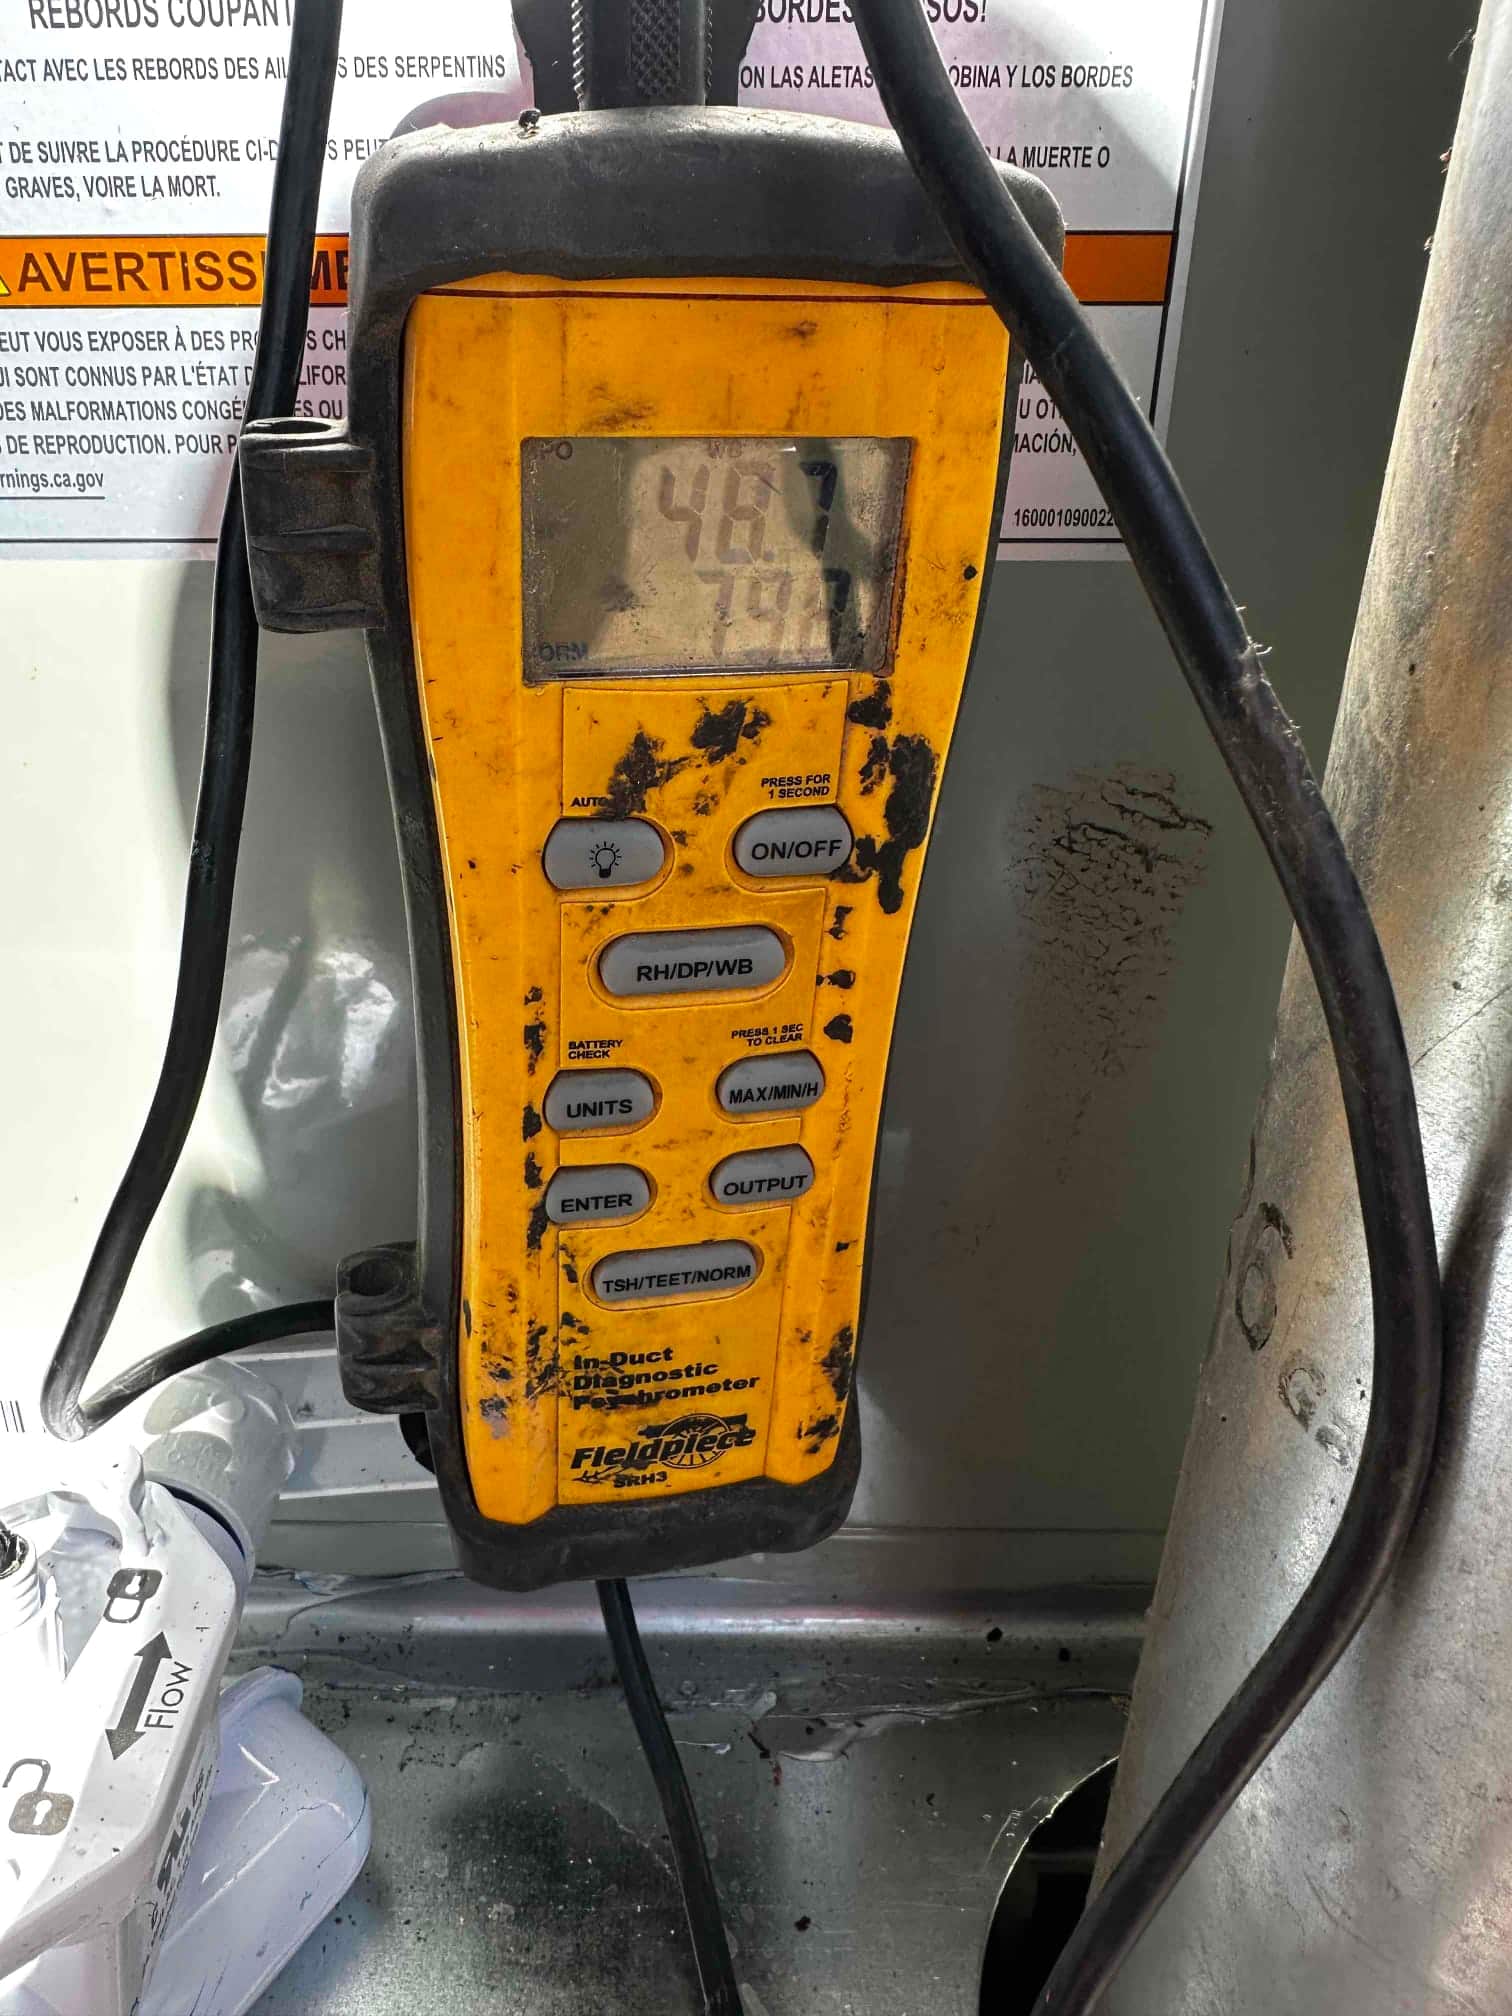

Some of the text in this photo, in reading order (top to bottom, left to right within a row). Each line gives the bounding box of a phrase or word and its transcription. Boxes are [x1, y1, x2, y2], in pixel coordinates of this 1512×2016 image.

[29, 0, 160, 29] REBORDS
[0, 58, 37, 82] ACT
[43, 58, 89, 82] AVEC
[94, 58, 128, 81] LES
[133, 57, 219, 81] REBORDS
[224, 57, 260, 80] DES
[354, 56, 389, 78] DES
[395, 55, 506, 78] SERPENTINS
[740, 65, 874, 89] ON LAS ALETAS
[1006, 65, 1018, 88] Y
[1021, 65, 1056, 88] LOS
[1061, 65, 1134, 88] BORDES
[9, 141, 33, 164] DE
[38, 140, 101, 163] SUIVRE
[104, 140, 129, 163] LA
[132, 135, 241, 163] PROCÉDURE
[1023, 146, 1093, 169] MUERTE
[1098, 146, 1110, 168] O
[5, 175, 221, 202] GRAVES, VOIRE LA MORT.
[34, 331, 84, 352] VOUS
[87, 330, 170, 351] EXPOSER
[174, 325, 187, 351] À
[191, 331, 225, 351] DES
[14, 366, 60, 387] SONT
[65, 366, 138, 387] CONNUS
[141, 366, 178, 387] PAR
[181, 361, 239, 386] L'ÉTAT
[30, 400, 178, 421] MALFORMATIONS
[319, 400, 343, 419] OU
[6, 435, 30, 454] DE
[33, 434, 171, 455] REPRODUCTION.
[175, 434, 222, 454] POUR
[761, 774, 830, 788] PRESS FOR
[778, 786, 829, 798] SECOND
[752, 839, 842, 860] ON/OFF
[636, 958, 753, 982] RH/DP/WB
[731, 1027, 769, 1039] PRESS
[782, 1023, 803, 1033] SEC
[746, 1033, 802, 1047] TO CLEAR
[568, 1039, 623, 1050] BATTERY
[568, 1049, 610, 1060] CHECK
[729, 1082, 819, 1104] MAX/MIN/H
[566, 1099, 633, 1118] UNITS
[723, 1175, 808, 1196] OUTPUT
[560, 1193, 633, 1213] ENTER
[602, 1265, 752, 1293] TSH/TEET/NORM
[574, 1348, 673, 1370] In-Duct
[574, 1363, 719, 1390] Diagnostic
[614, 1471, 668, 1488] SRH3
[144, 1661, 192, 1729] Flow
